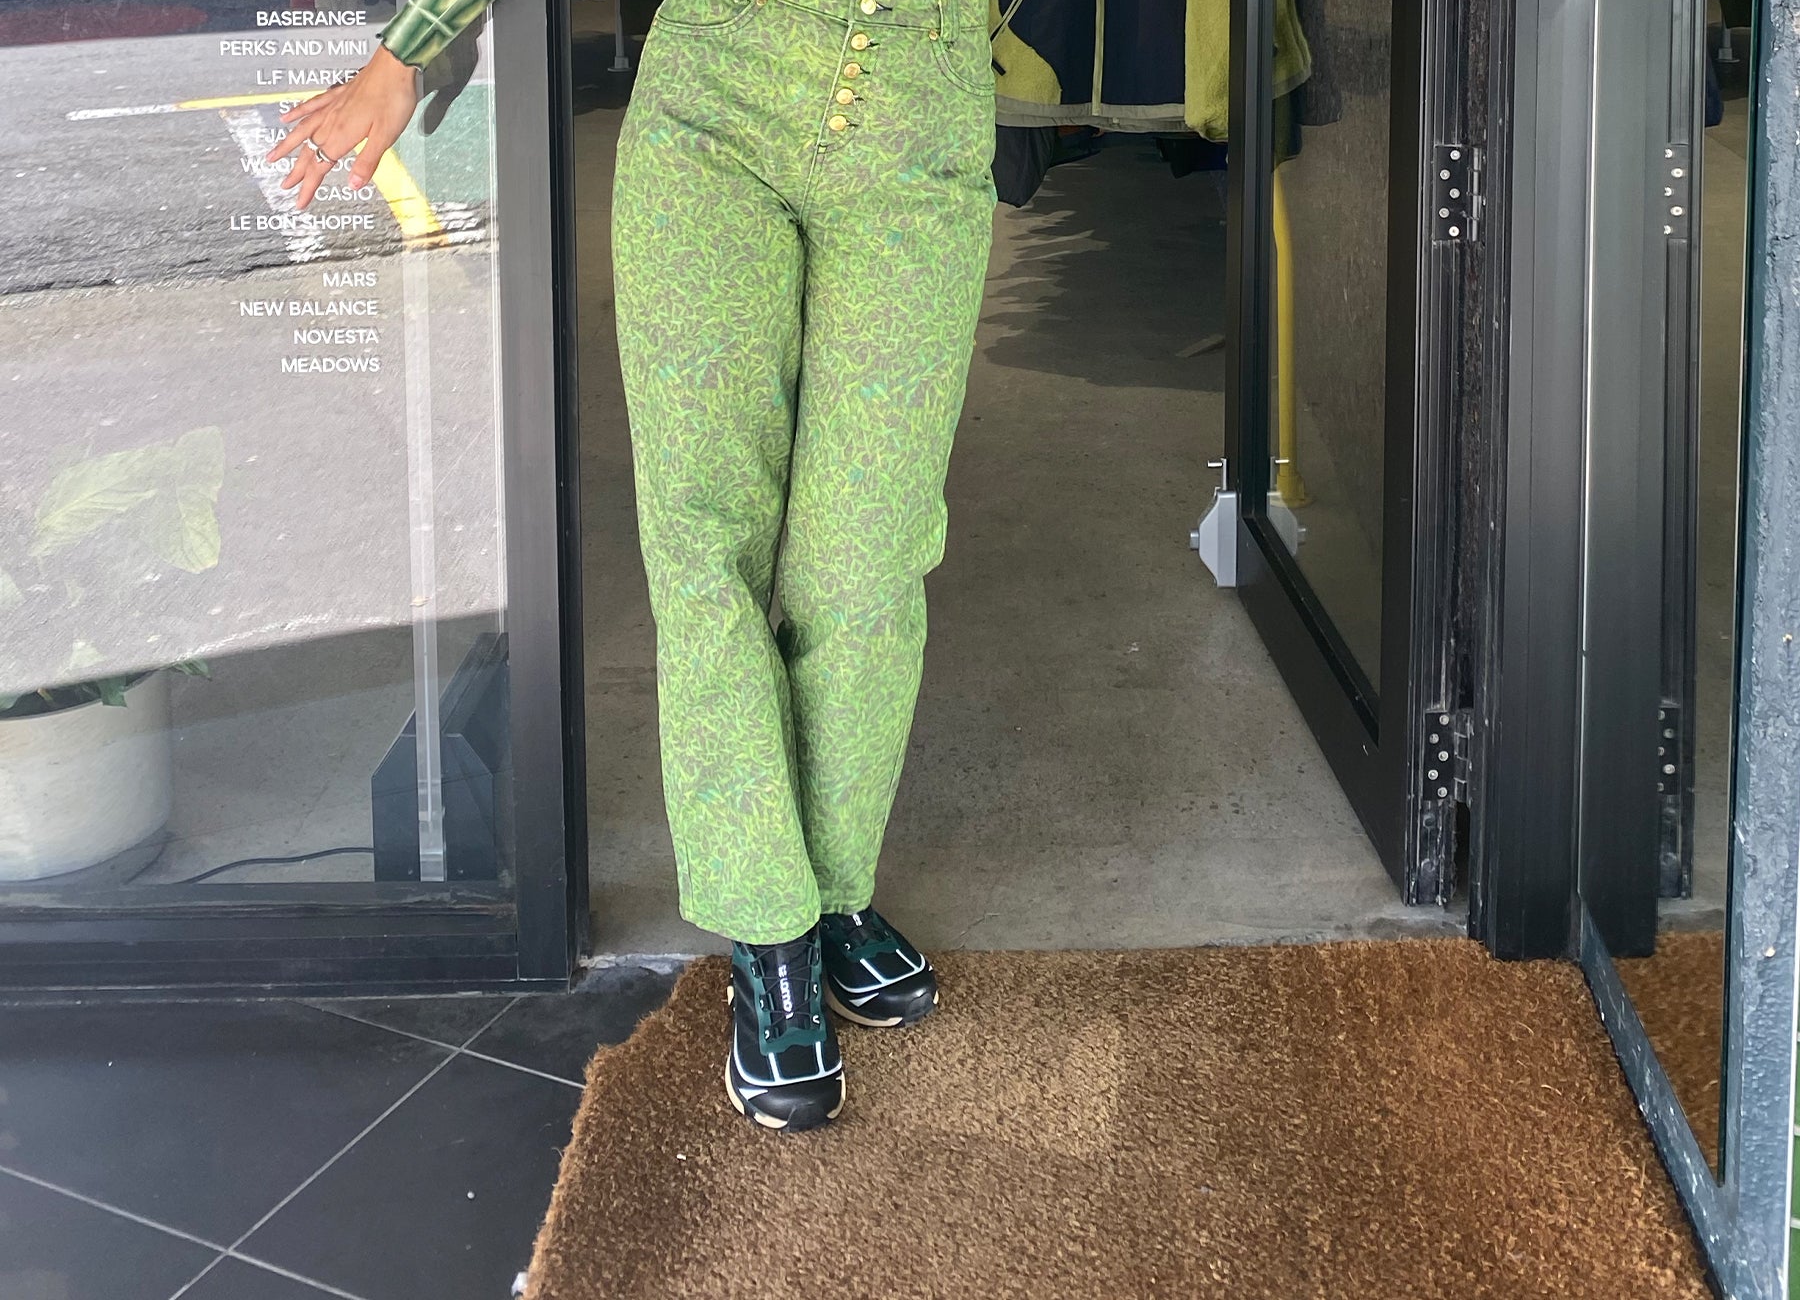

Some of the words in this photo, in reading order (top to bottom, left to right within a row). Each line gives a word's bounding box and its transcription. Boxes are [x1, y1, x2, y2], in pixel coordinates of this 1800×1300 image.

[256, 10, 367, 27] BASERANGE
[219, 40, 276, 56] PERKS
[281, 40, 322, 55] AND
[327, 40, 368, 55] MINI
[256, 70, 282, 85] L.F
[288, 70, 360, 85] MARKE
[315, 185, 373, 201] CASIO
[230, 216, 250, 231] LE
[256, 215, 296, 230] BON
[302, 214, 374, 230] SHOPPE
[322, 272, 377, 288] MARS
[239, 301, 284, 317] NEW
[289, 301, 378, 316] BALANCE
[293, 329, 379, 345] NOVESTA
[281, 357, 380, 374] MEADOWS
